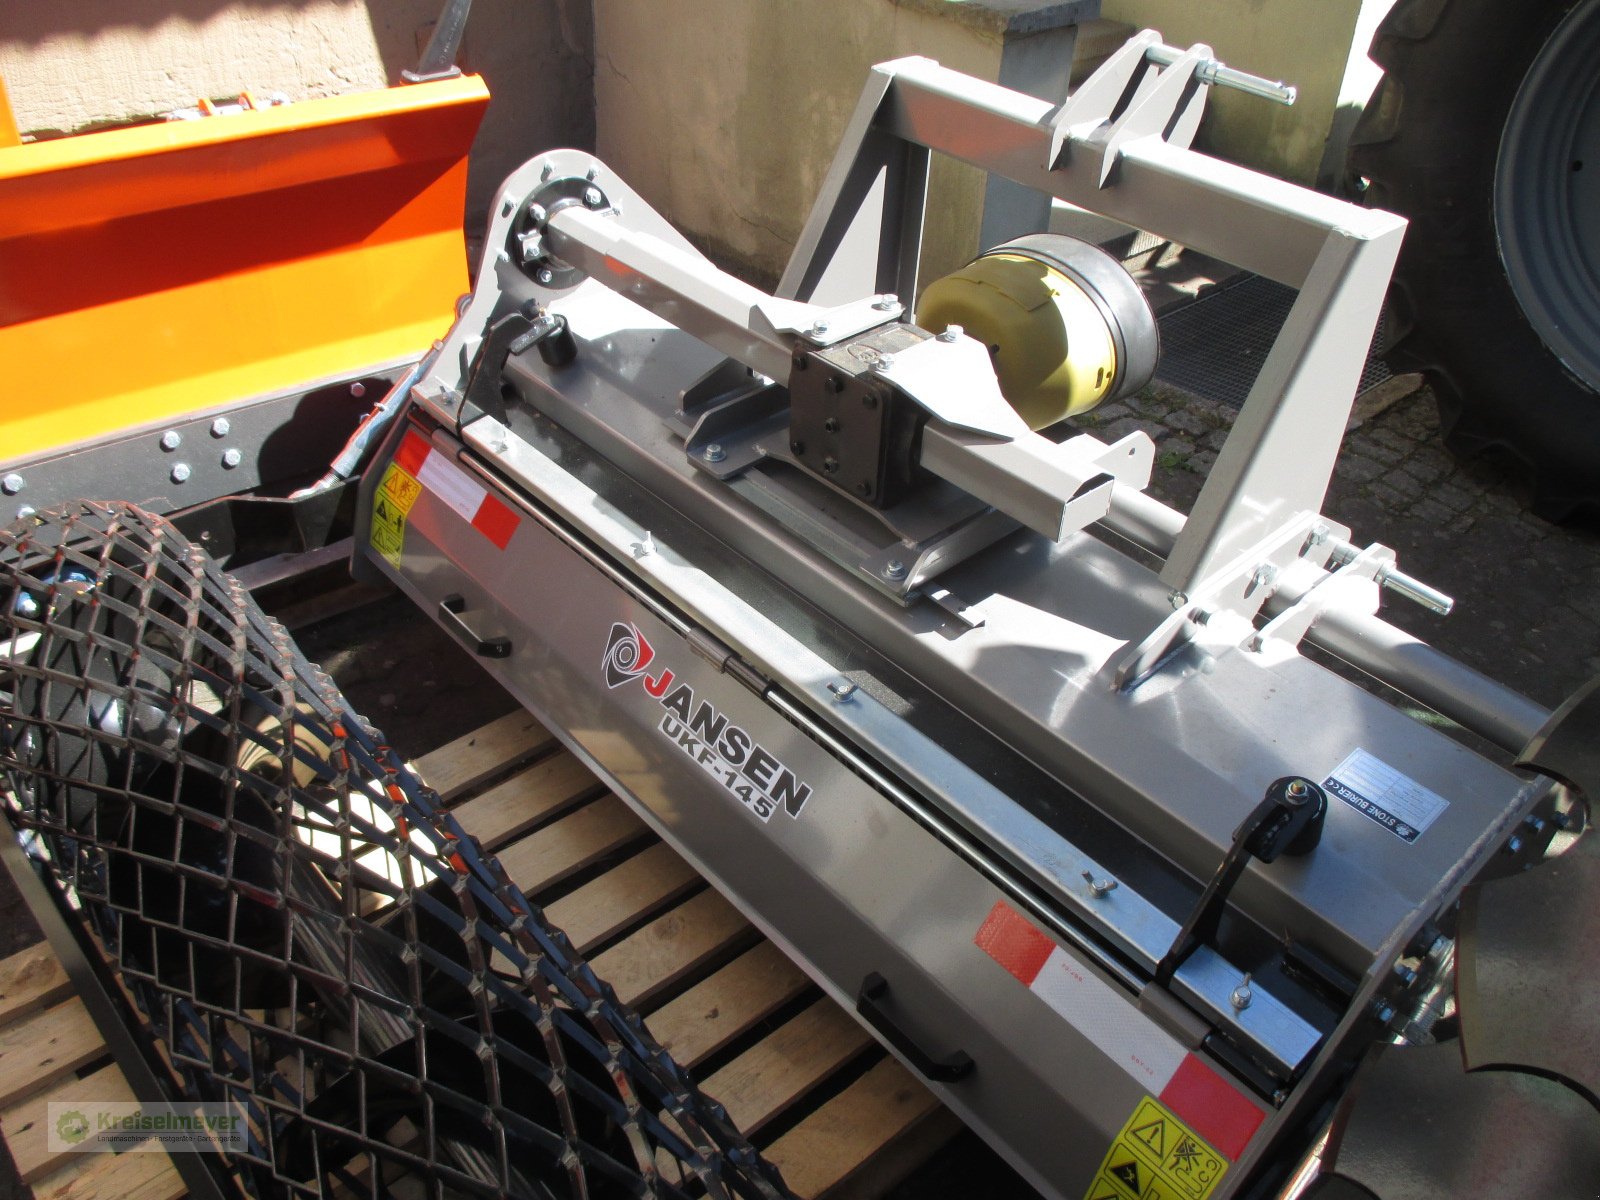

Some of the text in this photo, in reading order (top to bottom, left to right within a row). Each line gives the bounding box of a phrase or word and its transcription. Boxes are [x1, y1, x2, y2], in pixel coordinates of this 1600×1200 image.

[643, 667, 812, 818] JANSEN
[661, 714, 773, 819] UKF-145
[1338, 786, 1370, 809] BURIER
[1367, 806, 1396, 826] STONE
